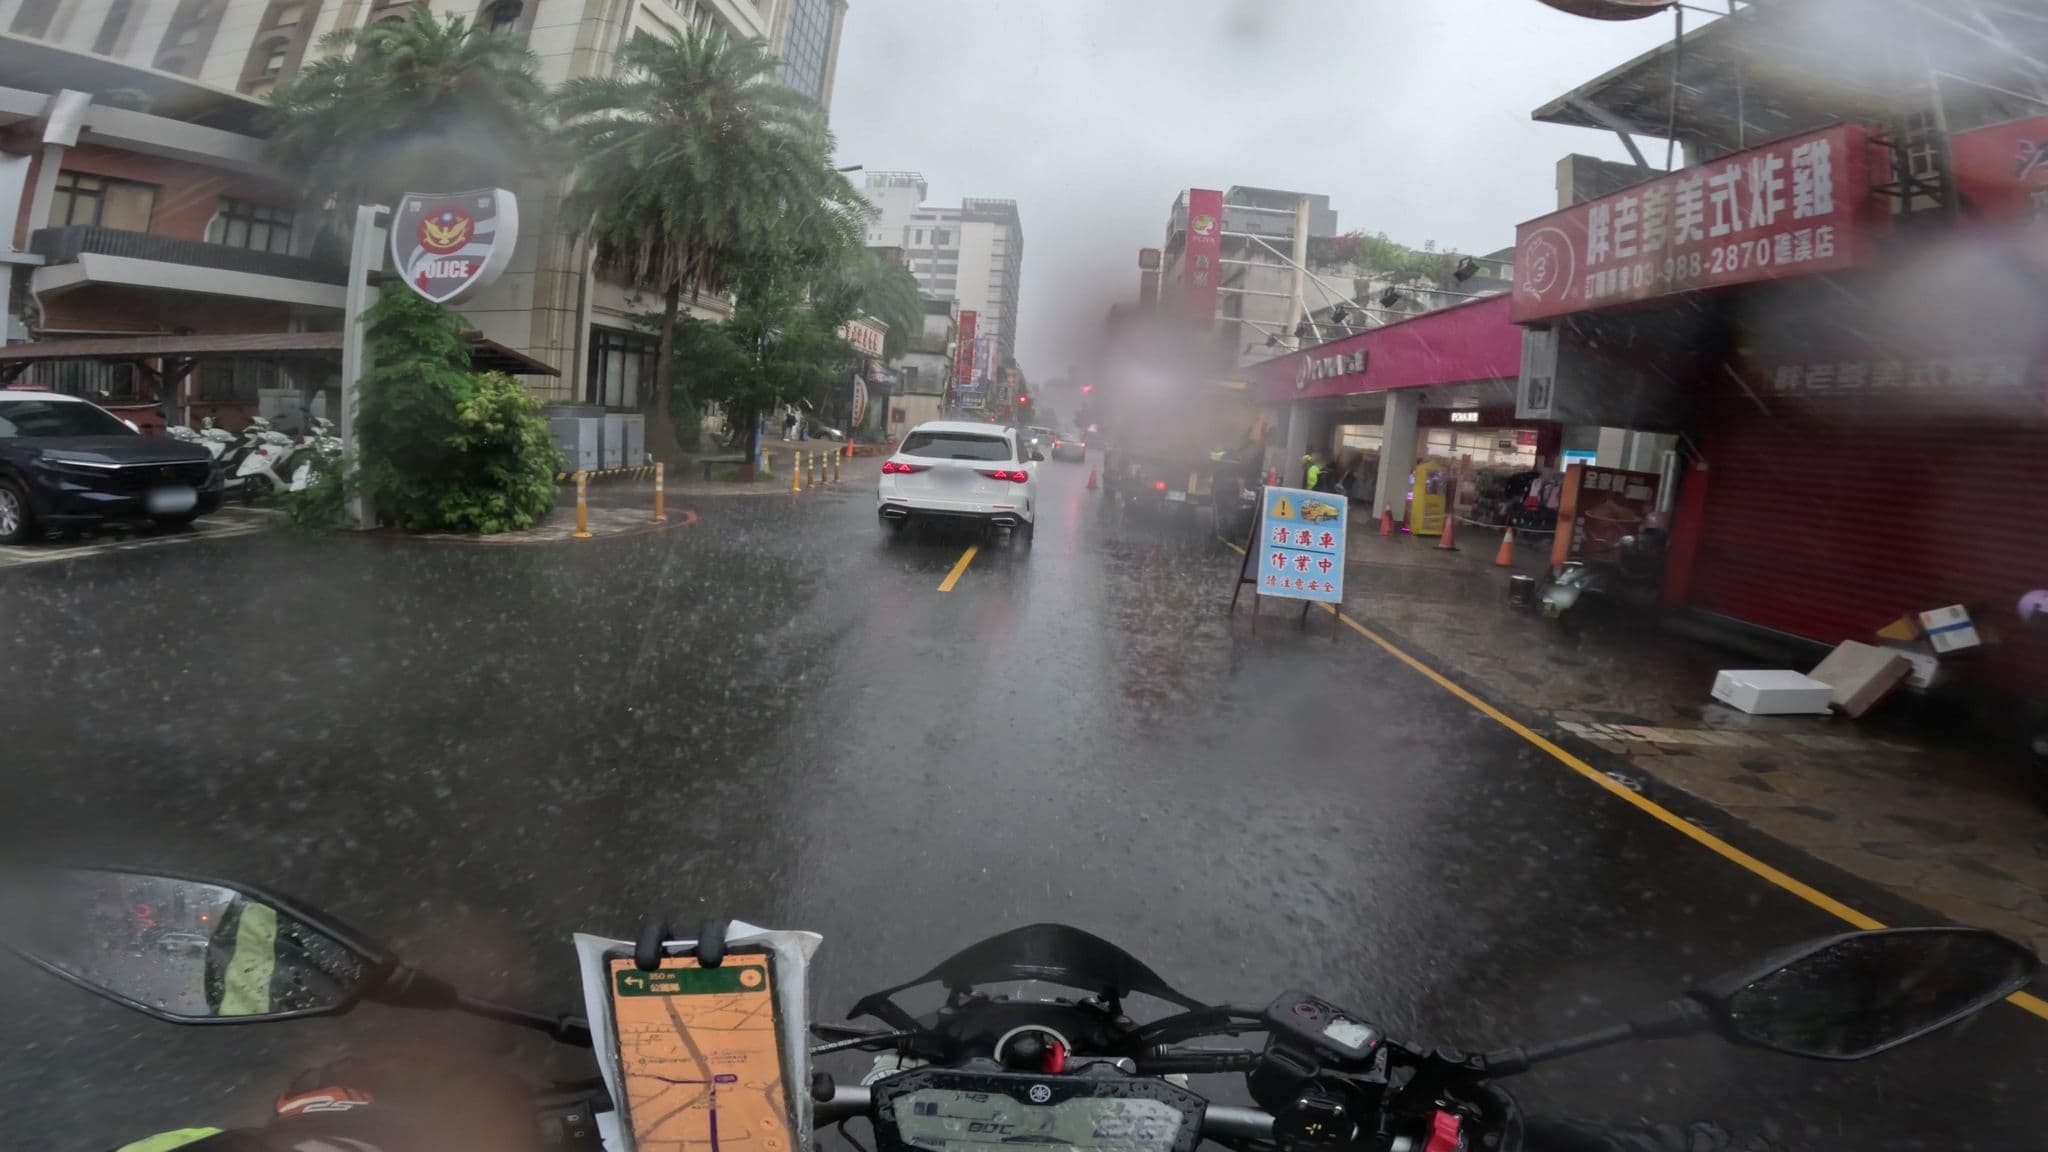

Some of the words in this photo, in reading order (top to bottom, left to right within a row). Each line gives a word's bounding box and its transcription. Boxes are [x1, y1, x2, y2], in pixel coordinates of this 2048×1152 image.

[1586, 139, 1834, 266] 胖老爹美式炸雞
[416, 260, 469, 279] POLICE
[1272, 526, 1336, 550] 清溝車
[1271, 552, 1334, 574] 作業中
[1266, 574, 1335, 593] 請注意安全
